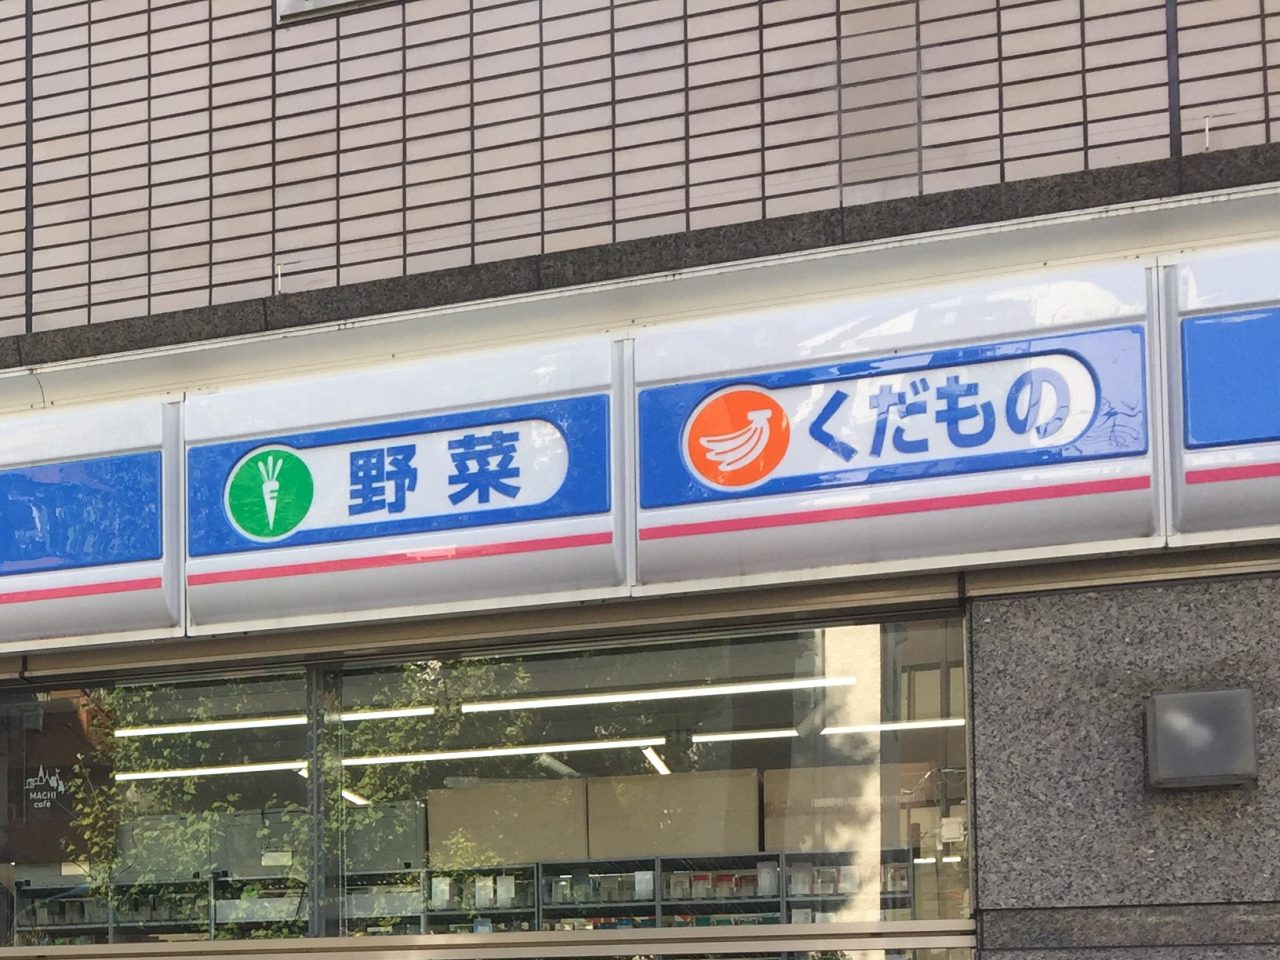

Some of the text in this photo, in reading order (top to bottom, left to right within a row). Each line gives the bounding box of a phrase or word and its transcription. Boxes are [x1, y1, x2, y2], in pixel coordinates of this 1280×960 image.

[808, 366, 1071, 463] くだもの
[348, 430, 521, 517] 野菜
[29, 791, 57, 800] MACHI
